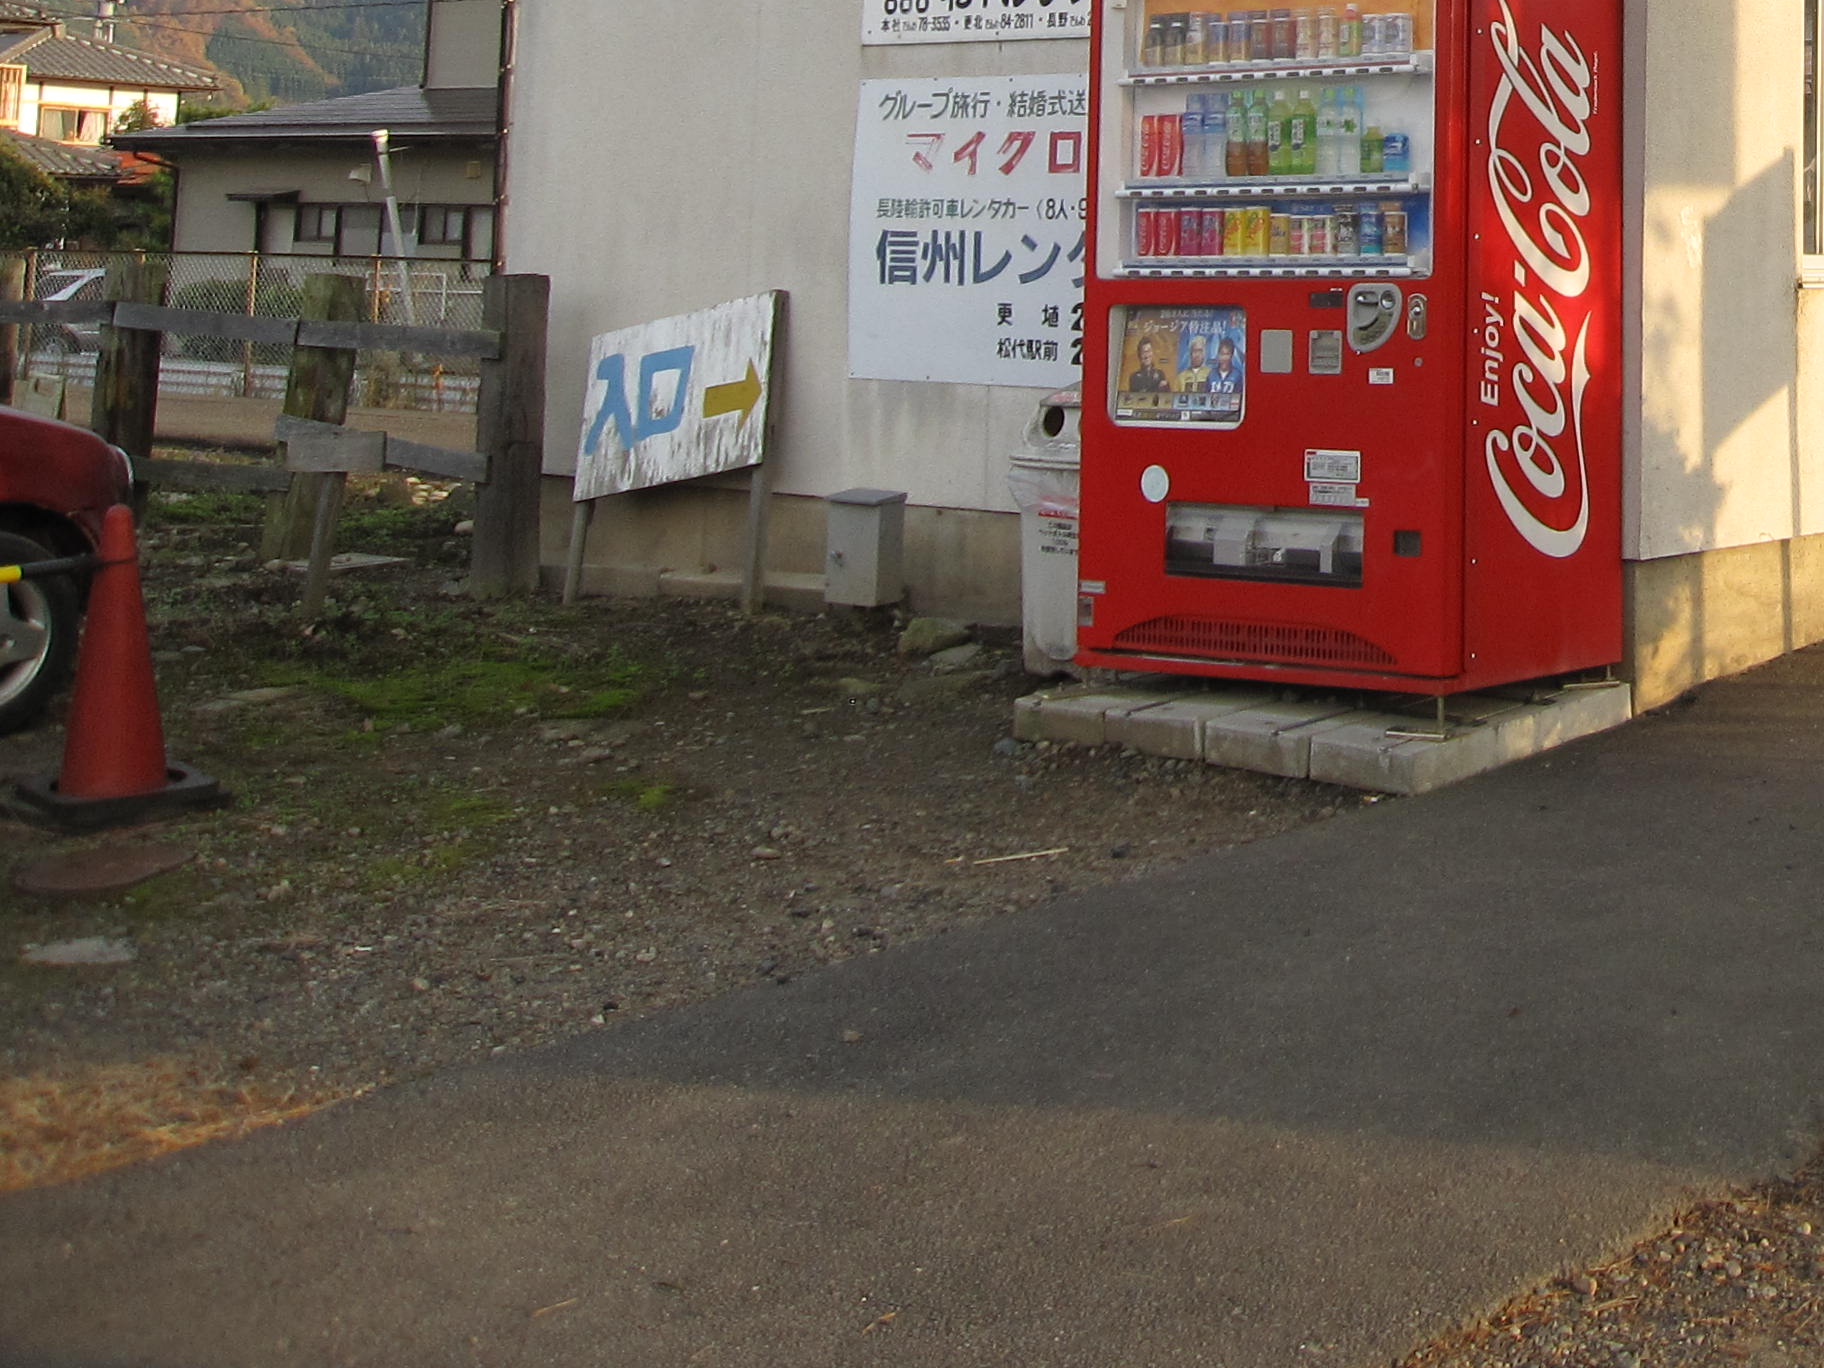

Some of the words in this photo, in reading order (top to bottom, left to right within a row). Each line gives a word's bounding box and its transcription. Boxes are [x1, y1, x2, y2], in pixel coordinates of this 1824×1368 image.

[905, 131, 1082, 175] マイクロ
[996, 336, 1059, 362] 松代駅前
[1479, 290, 1507, 407] Enjoy!
[583, 344, 697, 458] 入口
